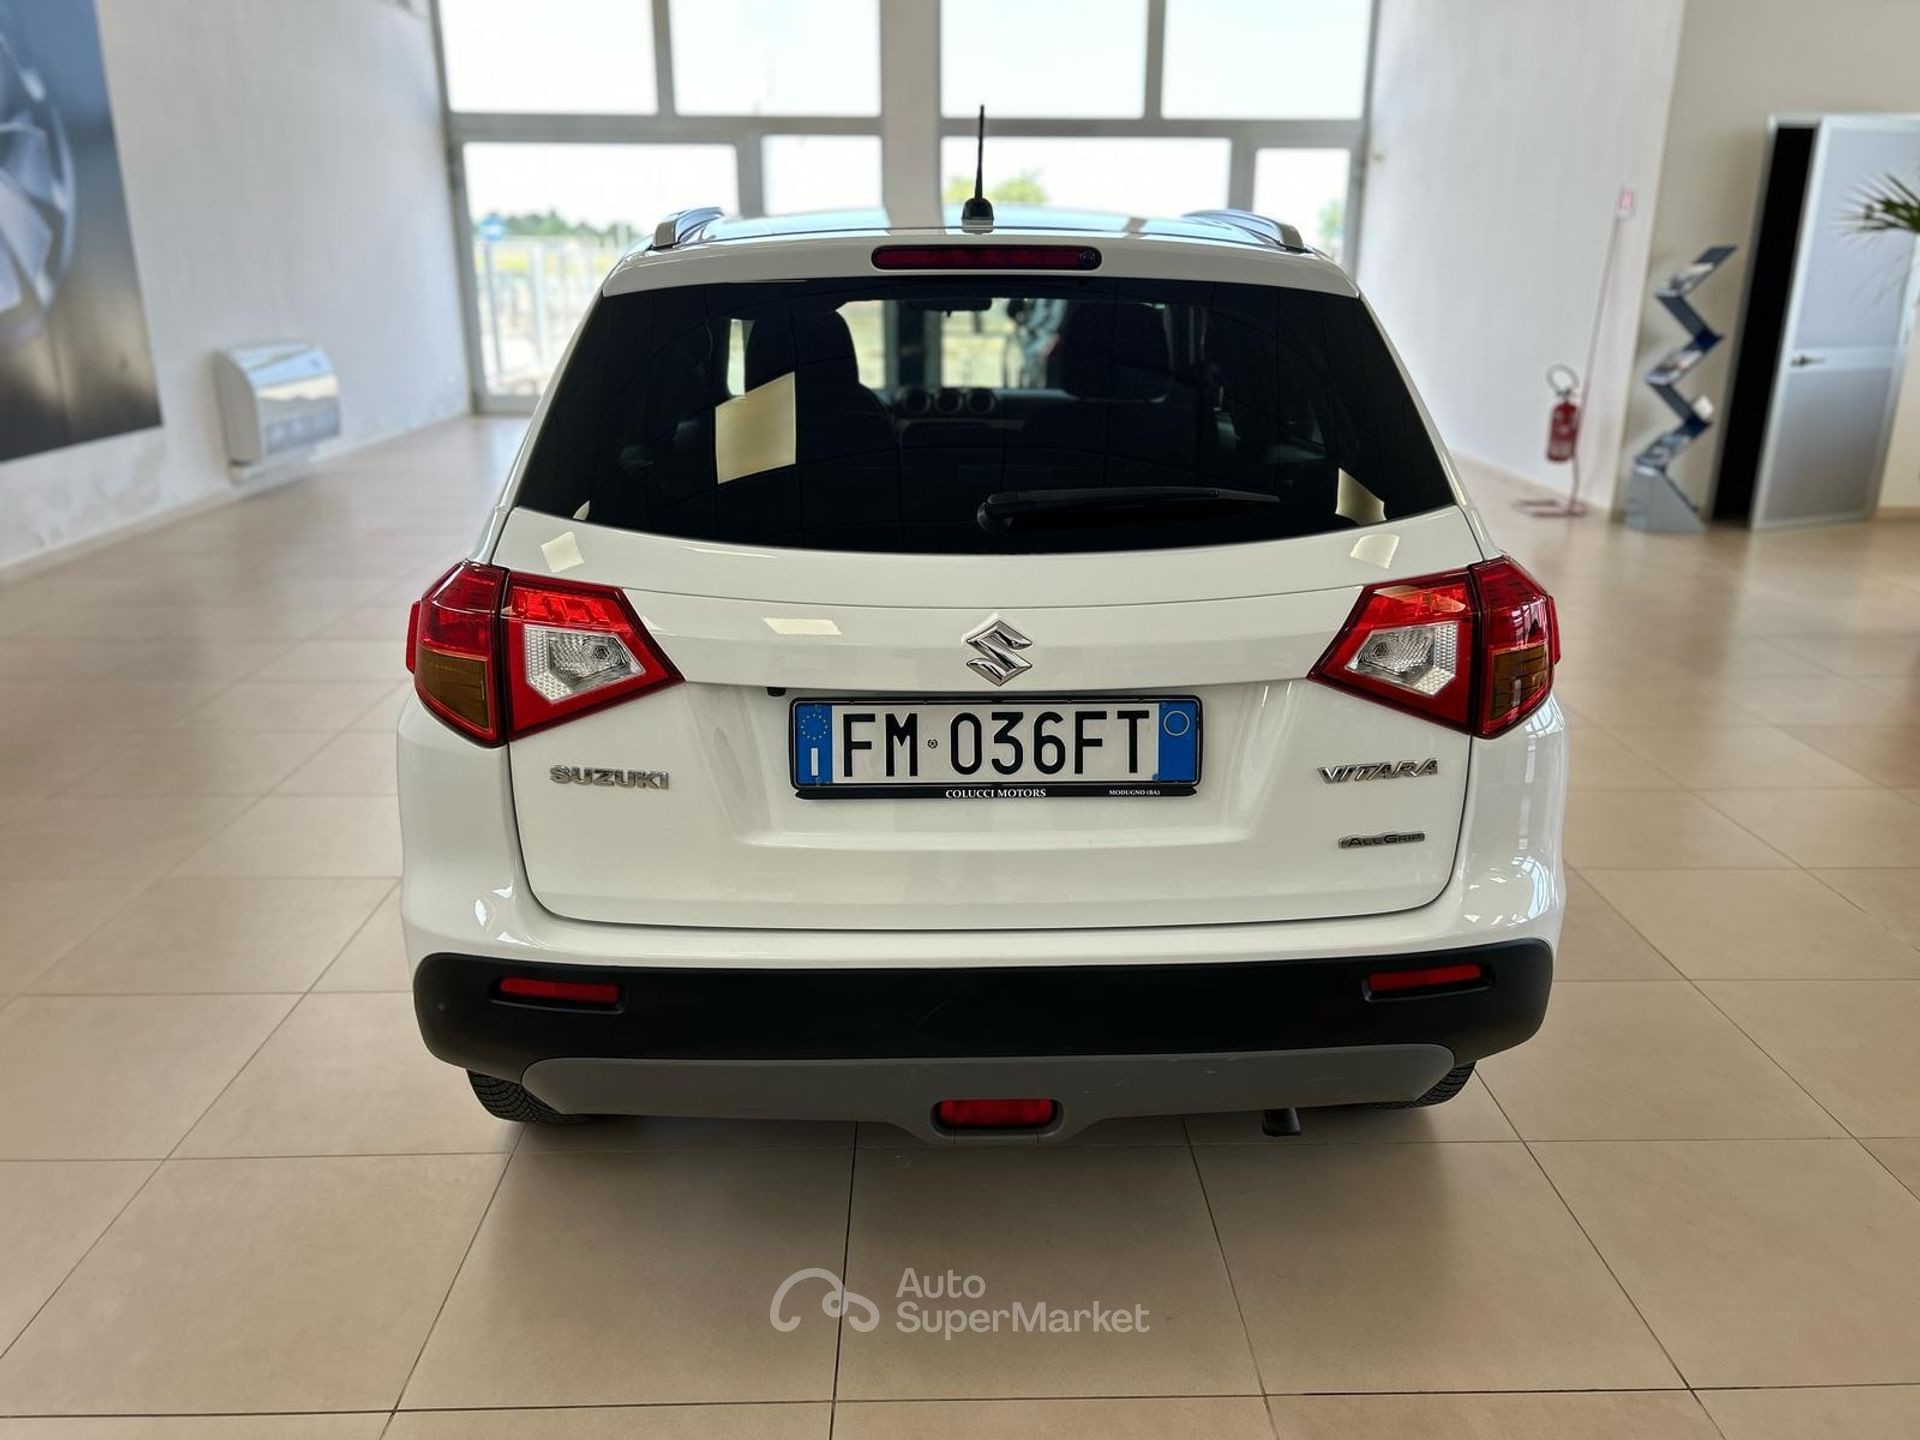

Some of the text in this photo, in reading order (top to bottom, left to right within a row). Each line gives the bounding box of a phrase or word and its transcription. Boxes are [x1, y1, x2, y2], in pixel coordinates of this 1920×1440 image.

[843, 713, 918, 777] FM
[950, 710, 1150, 775] 036FT
[549, 764, 669, 790] SUZUKI
[1317, 758, 1438, 784] VITARA
[945, 788, 1047, 798] COLUCCI MOTORS
